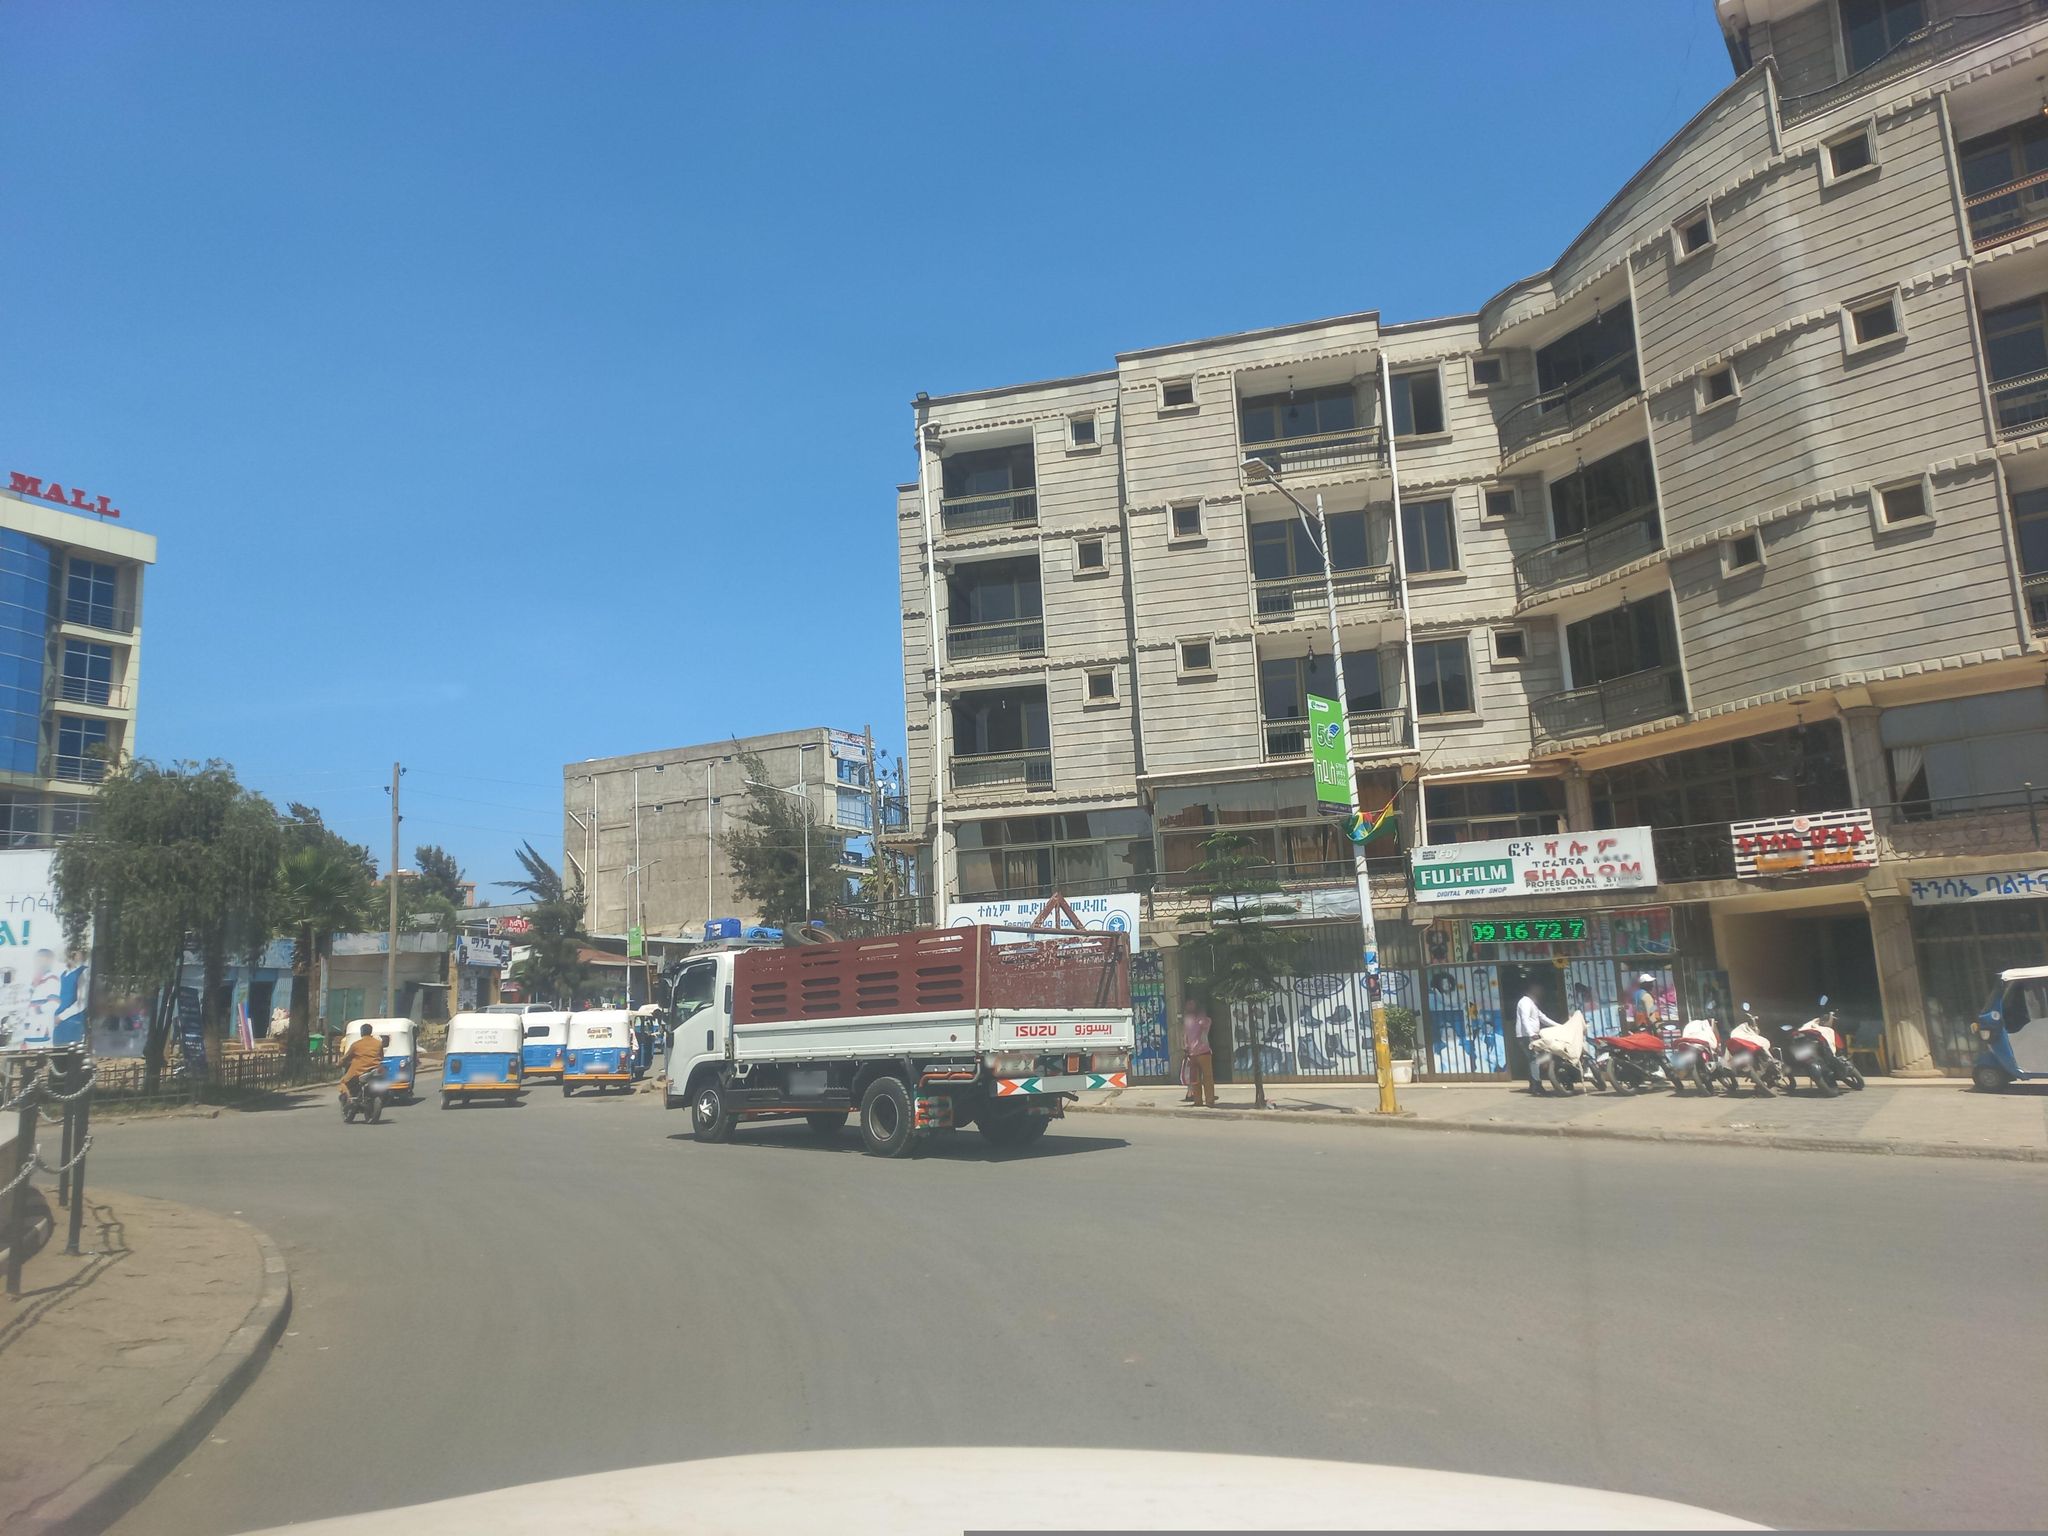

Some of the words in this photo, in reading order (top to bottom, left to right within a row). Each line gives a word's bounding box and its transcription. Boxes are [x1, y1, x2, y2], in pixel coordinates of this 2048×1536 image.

[9, 471, 120, 518] MALL
[1508, 841, 1534, 857] ፎቶ
[1420, 864, 1507, 885] FUJIFILM
[1524, 862, 1641, 882] SHALOM
[1526, 877, 1597, 888] PROFESSIONAL
[1436, 890, 1460, 898] DIGITAL
[1465, 888, 1485, 896] PRINT
[1504, 924, 1528, 939] 16
[1535, 923, 1562, 938] 72
[1016, 1025, 1057, 1037] ISUZU
